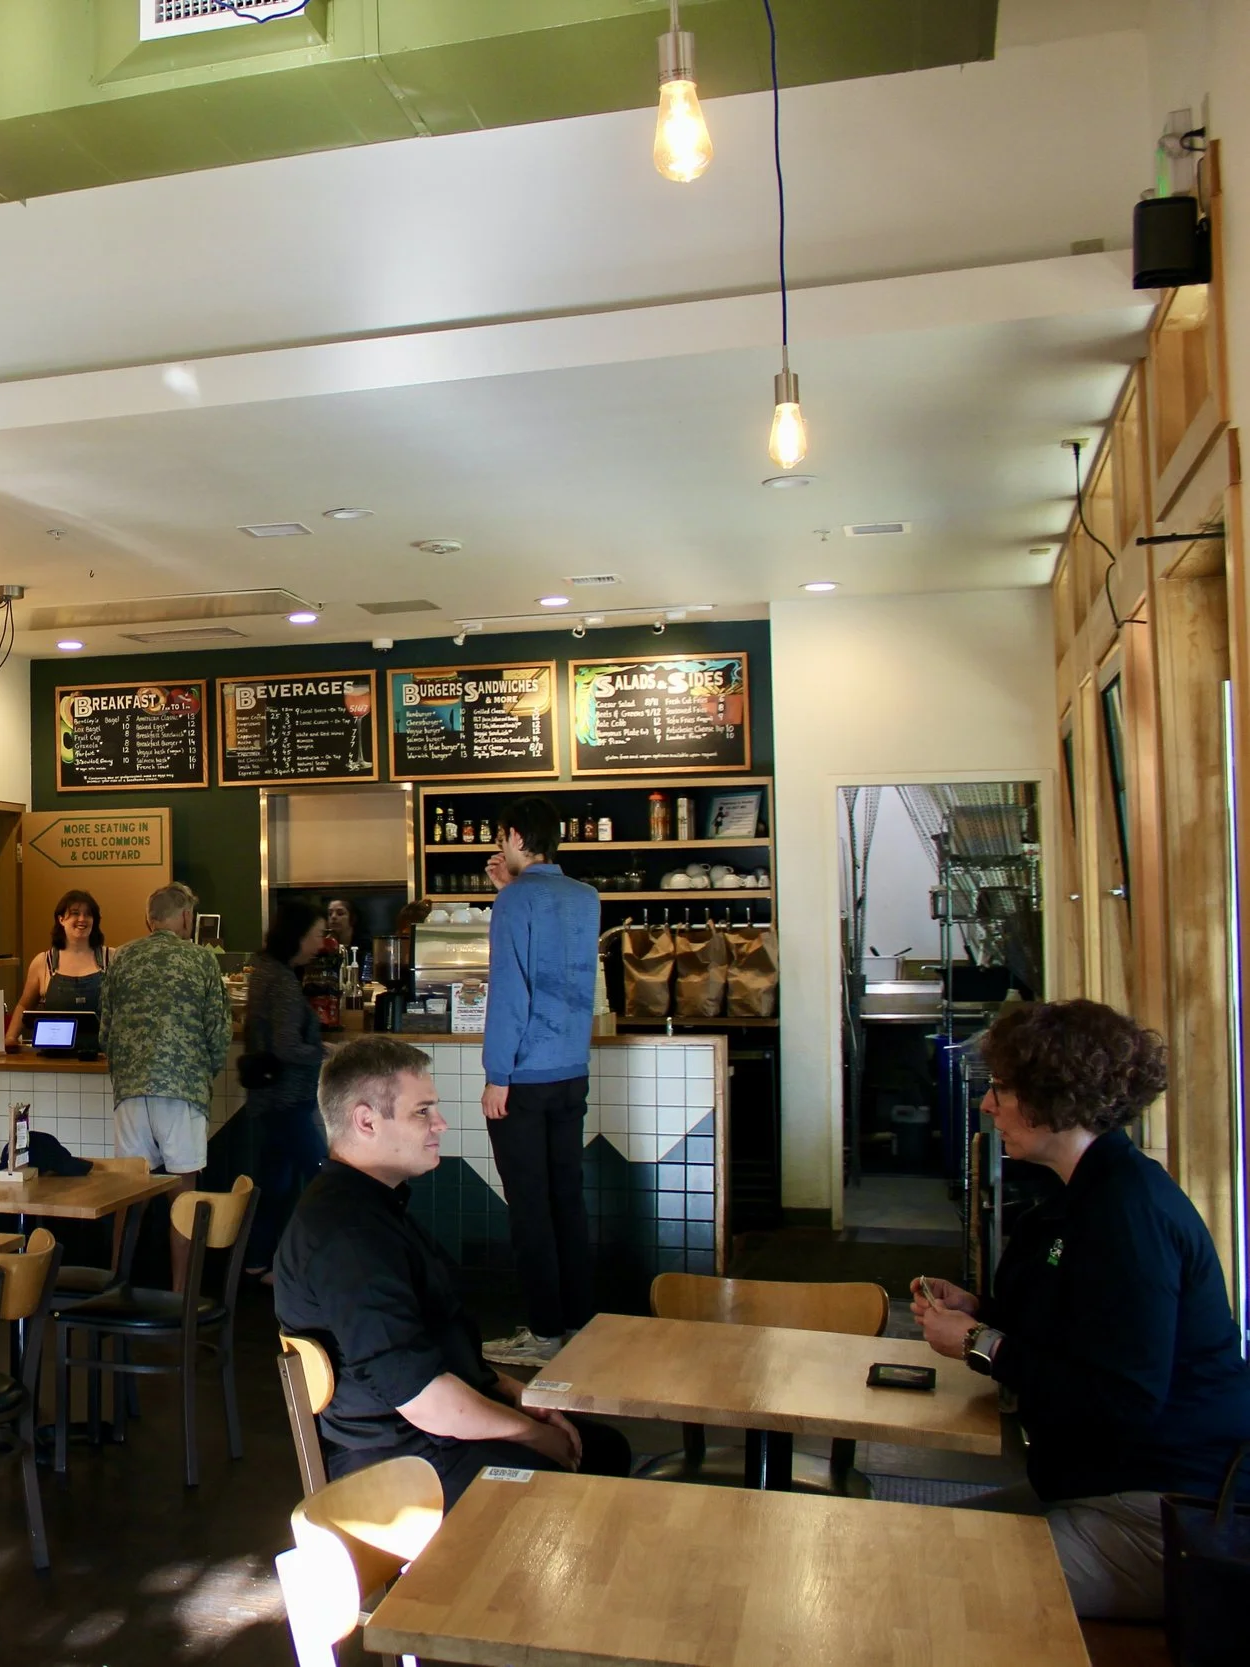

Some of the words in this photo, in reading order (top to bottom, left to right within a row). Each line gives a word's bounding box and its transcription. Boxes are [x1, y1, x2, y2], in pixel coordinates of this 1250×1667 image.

[594, 674, 656, 698] SALADS
[656, 680, 668, 690] &
[668, 671, 724, 694] SIDES
[236, 681, 355, 710] BEVERAGES
[403, 682, 463, 706] BURGERS
[464, 680, 539, 703] SANDWICHES
[74, 694, 157, 717] BREAKFAST
[666, 697, 680, 705] Fresh
[666, 706, 692, 715] Seasoned
[718, 703, 724, 711] 8
[105, 716, 120, 725] Bagel
[654, 718, 662, 726] 12
[86, 726, 101, 735] Bagel
[623, 728, 640, 736] Plate
[726, 724, 735, 732] 10
[136, 731, 160, 739] Breakfast
[656, 735, 661, 743] 9
[136, 740, 160, 748] Breakfast
[161, 740, 178, 748] Burger
[64, 824, 90, 834] MORE
[94, 823, 135, 833] SEATING
[139, 823, 148, 832] IN
[61, 837, 97, 848] HOSTEL
[102, 836, 150, 846] COMMONS
[71, 852, 77, 861] &
[82, 850, 140, 861] COURTYARD
